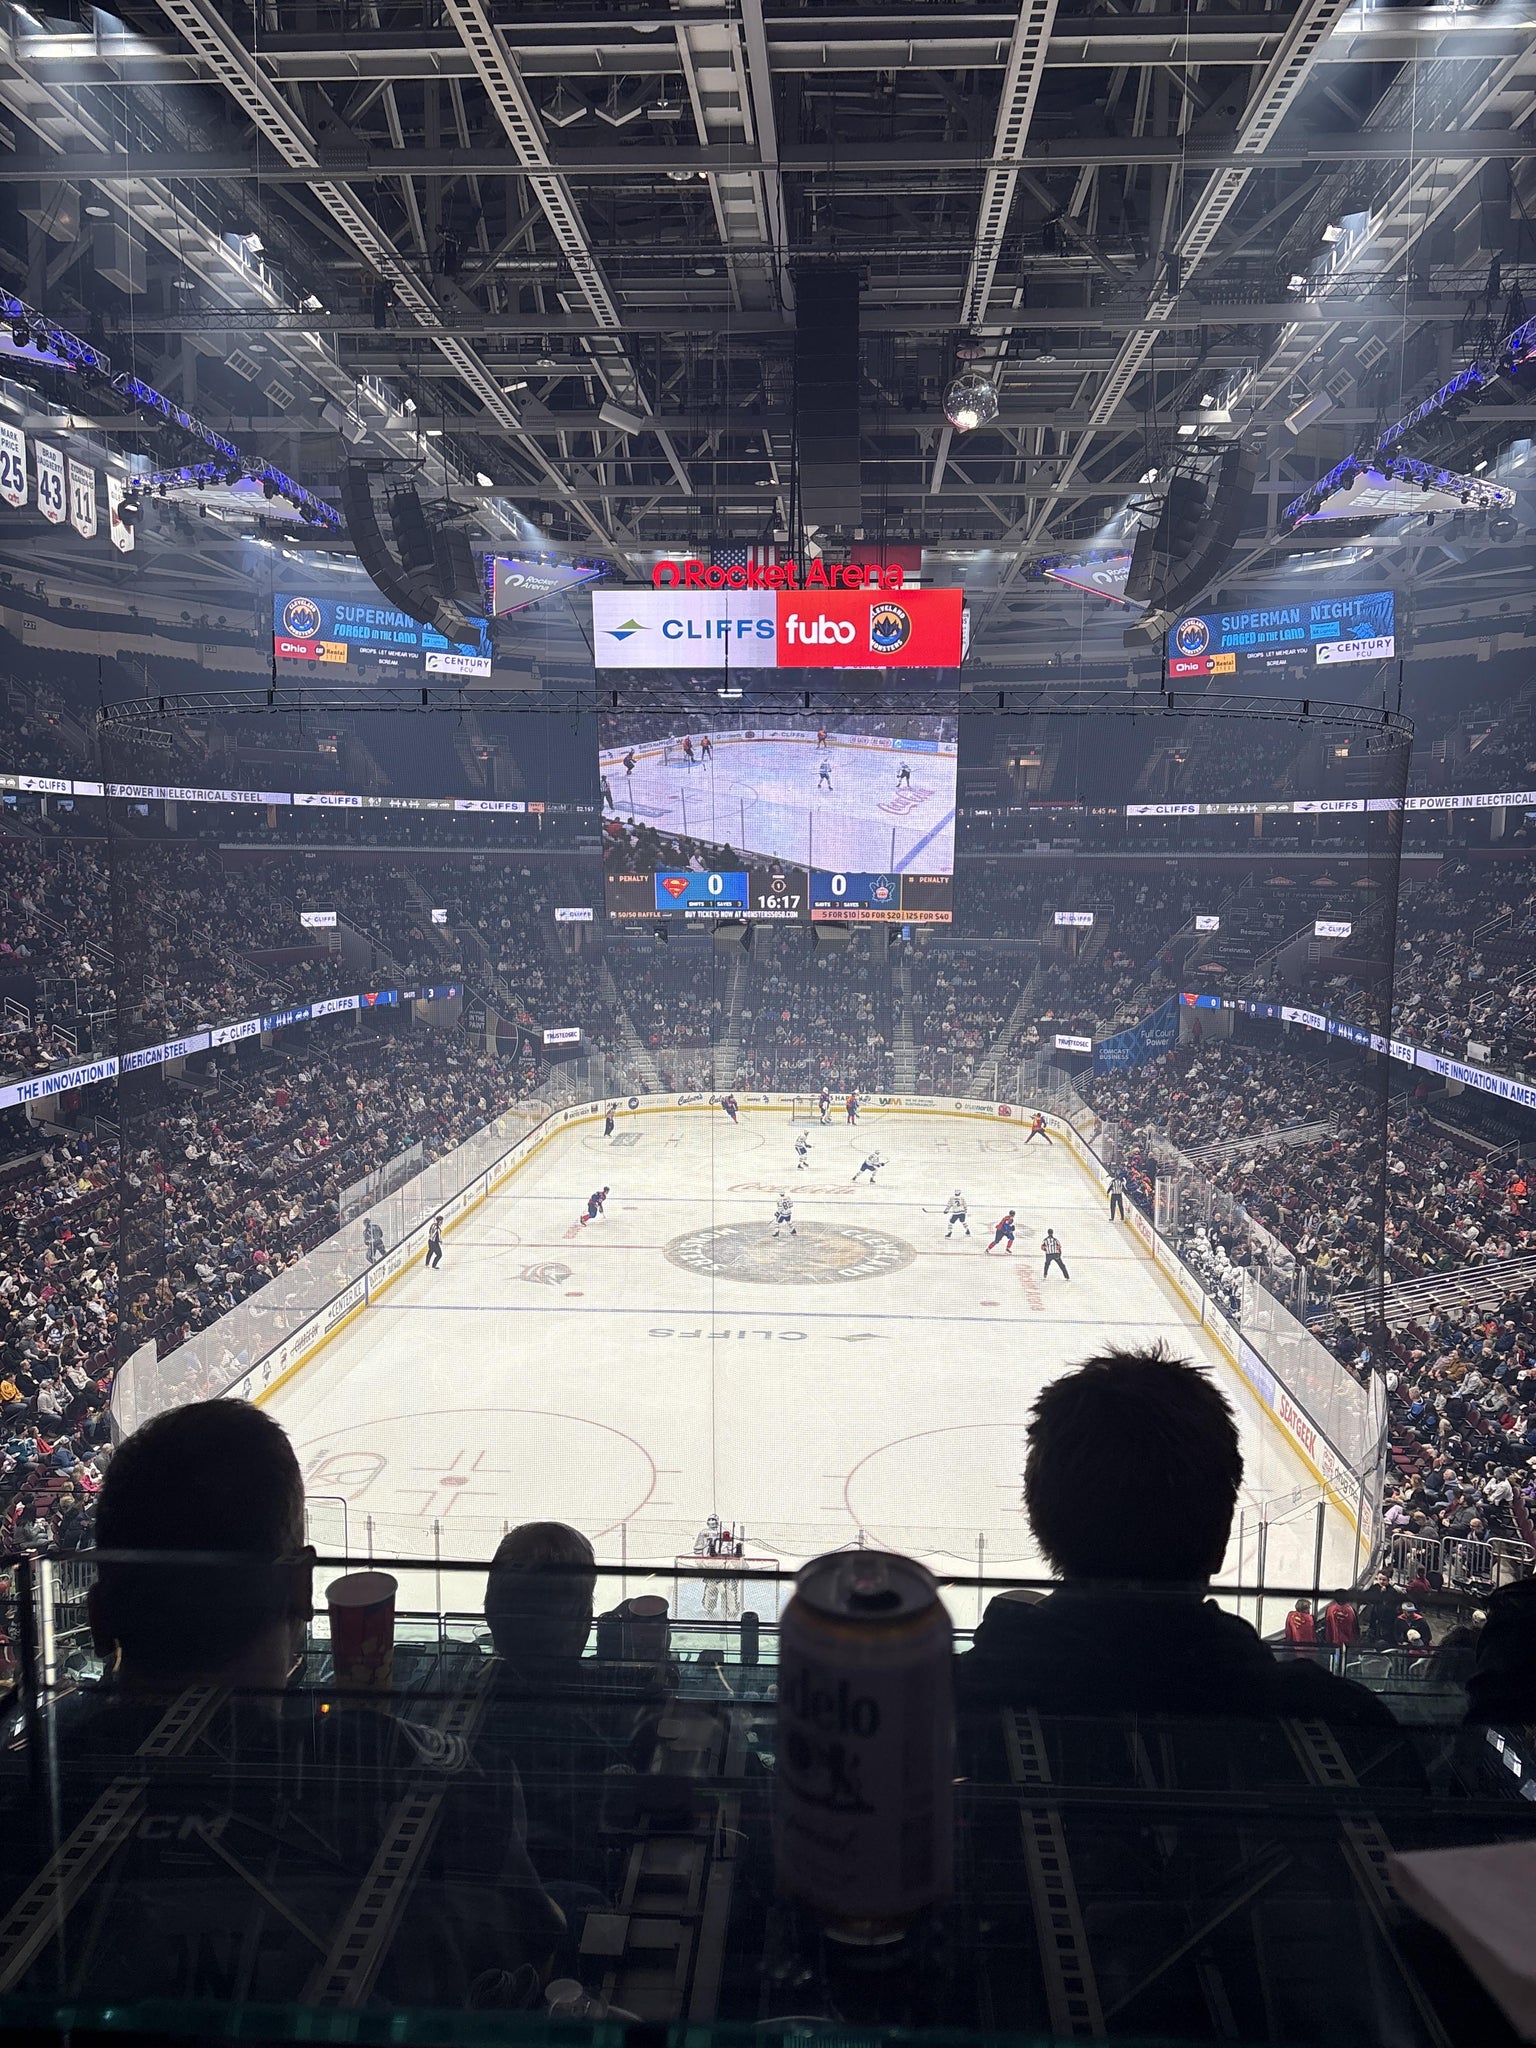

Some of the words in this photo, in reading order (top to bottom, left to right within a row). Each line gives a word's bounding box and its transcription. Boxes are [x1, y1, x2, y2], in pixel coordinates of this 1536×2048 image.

[1, 427, 18, 441] MARK
[1, 438, 19, 453] PRICE
[0, 450, 25, 493] 25
[40, 470, 62, 510] 43
[74, 487, 92, 524] 11
[685, 560, 797, 588] Rocket
[804, 558, 904, 588] Arena
[521, 583, 550, 591] Arena
[526, 576, 559, 586] Rocket
[335, 605, 414, 629] SUPERMAN
[1221, 608, 1300, 632] SUPERMAN
[1310, 600, 1364, 621] NIGHT
[333, 623, 371, 639] FORGED
[662, 619, 775, 640] CLIFFS
[785, 613, 856, 645] fubo
[280, 642, 307, 653] Ohio
[1221, 633, 1256, 648] FORGED
[1337, 638, 1392, 652] CENTURY
[444, 656, 490, 668] CENTURY
[1176, 663, 1199, 672] Ohio
[38, 779, 67, 792] CLIFFS
[119, 785, 154, 798] POWER
[156, 787, 166, 798] IN
[168, 787, 228, 802] ELECTRICAL
[230, 790, 263, 803] STEEL
[320, 795, 359, 805] CLIFFS
[1419, 794, 1459, 808] POWER
[1461, 794, 1473, 807] IN
[1476, 791, 1534, 806] ELECTRICAL
[480, 801, 518, 811] CLIFFS
[1156, 804, 1195, 814] CLIFFS
[1320, 800, 1359, 811] CLIFFS
[707, 873, 723, 895] 0
[831, 874, 847, 896] 0
[919, 876, 949, 884] PENALTY
[758, 895, 801, 909] 16:17
[843, 911, 857, 919] $10
[906, 912, 918, 920] 125
[428, 988, 434, 998] 3
[327, 998, 354, 1013] CLIFFS
[1210, 998, 1216, 1007] 0
[1251, 1003, 1256, 1011] 0
[1302, 1012, 1321, 1028] CLIFFS
[230, 1022, 256, 1039] CLIFFS
[1140, 1030, 1154, 1038] Full
[1155, 1029, 1175, 1038] Court
[1146, 1038, 1169, 1046] Power
[16, 1082, 40, 1102] THE
[42, 1065, 104, 1095] INNOVATION
[106, 1060, 116, 1076] IN
[164, 1041, 188, 1060] STEEL
[1435, 1058, 1450, 1076] THE
[1450, 1067, 1498, 1093] INNOVATION
[1499, 1082, 1509, 1096] IN
[331, 1292, 354, 1318] CENTER
[353, 1282, 362, 1298] ICE
[648, 1327, 808, 1341] CLIFFS
[1279, 1393, 1317, 1460] SEATGEEK
